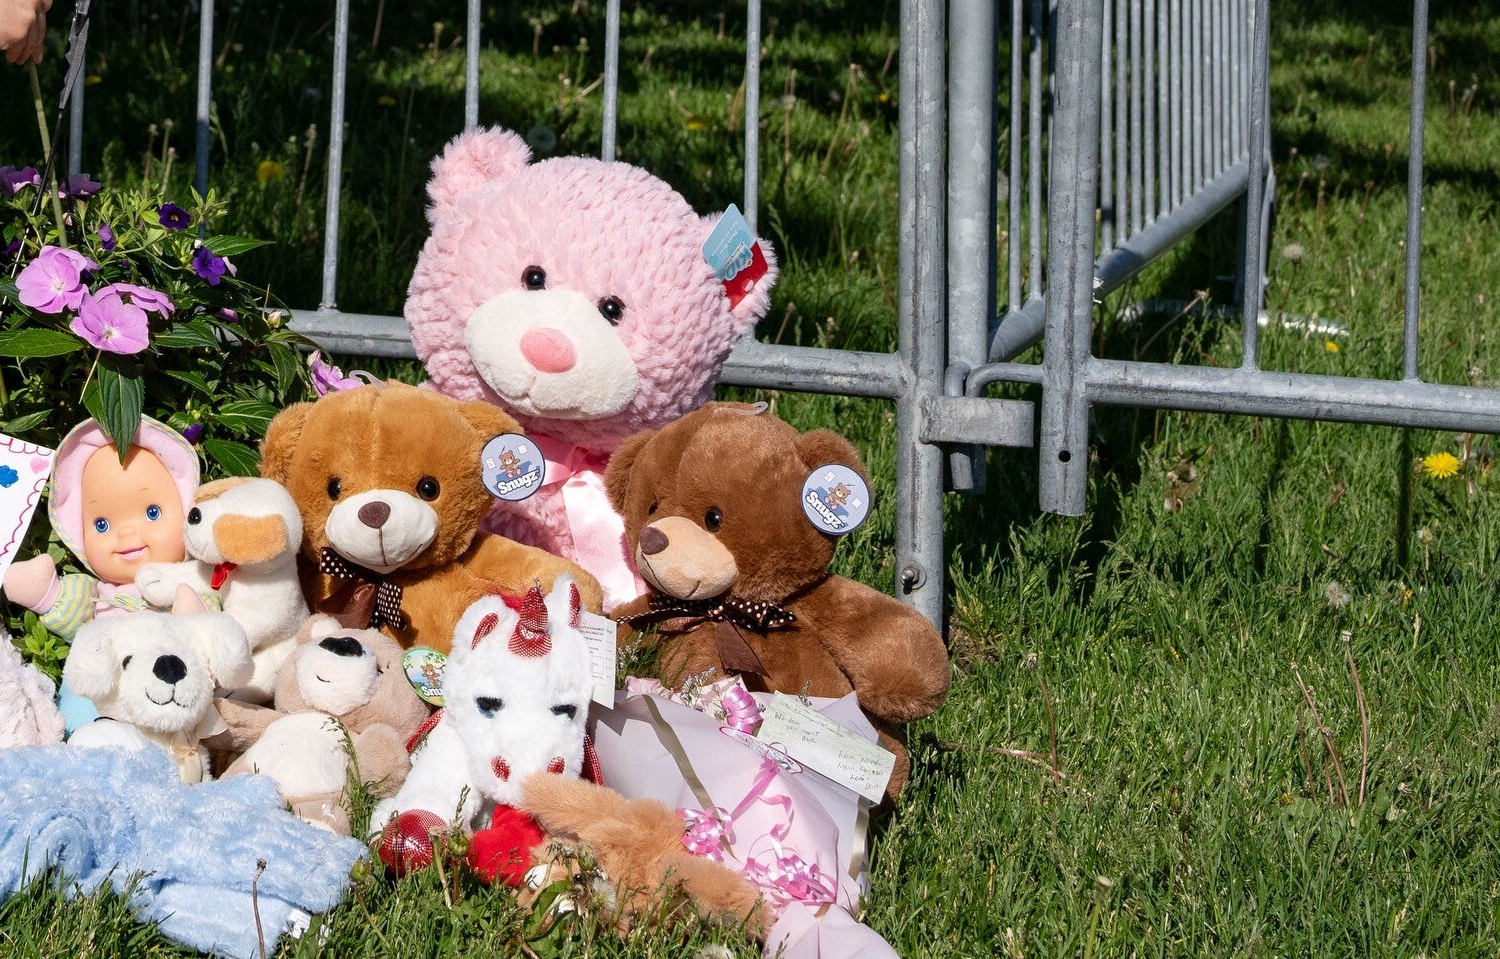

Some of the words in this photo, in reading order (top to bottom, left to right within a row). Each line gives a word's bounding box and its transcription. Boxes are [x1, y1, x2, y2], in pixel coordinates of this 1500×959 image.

[497, 469, 540, 495] Snugz
[806, 491, 845, 529] Snugz
[421, 685, 442, 697] Snu
